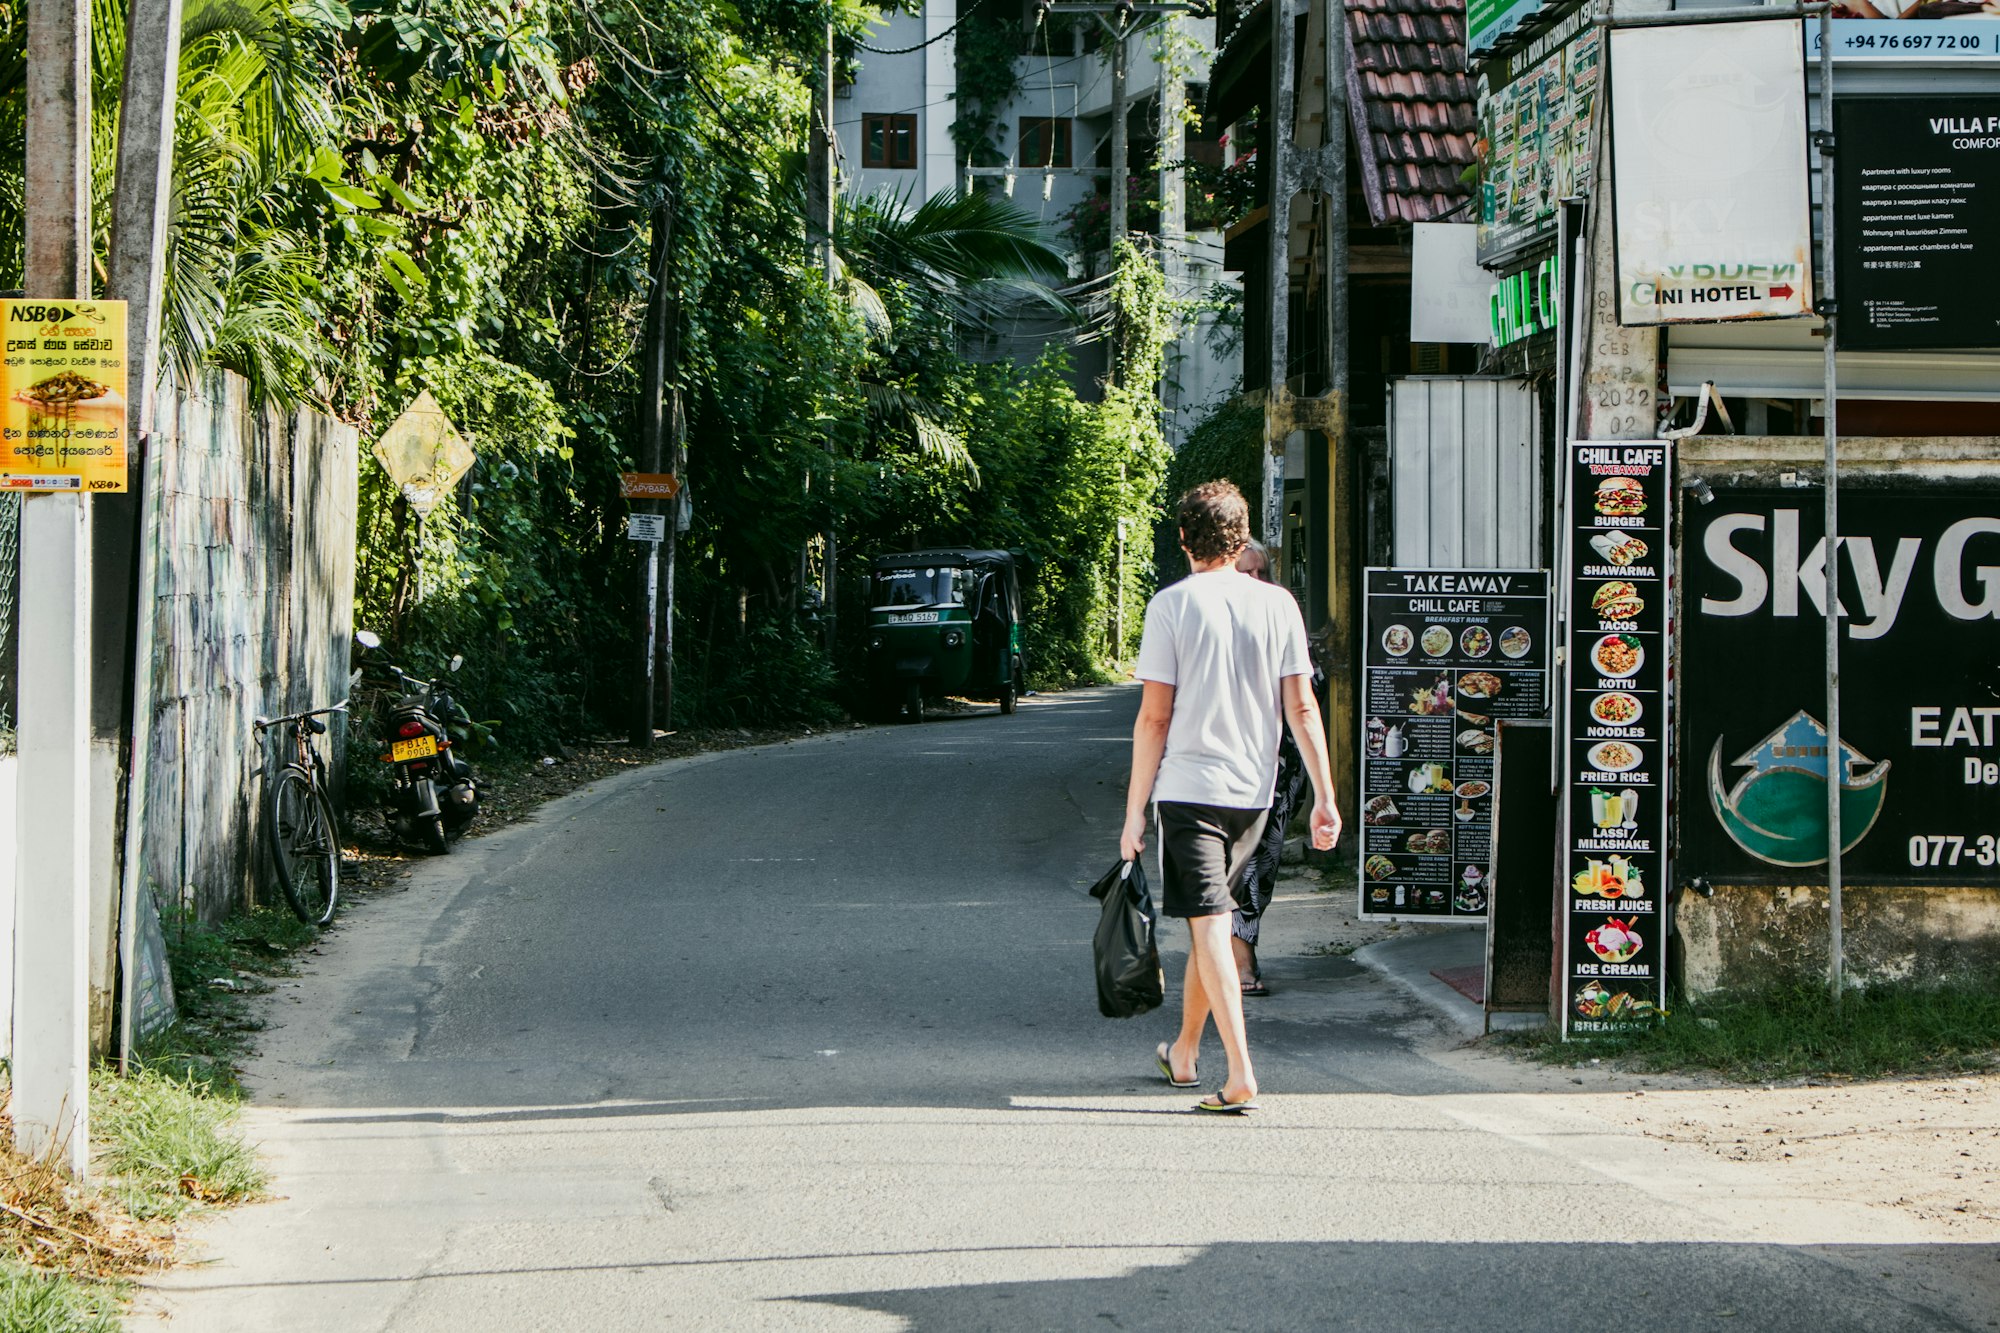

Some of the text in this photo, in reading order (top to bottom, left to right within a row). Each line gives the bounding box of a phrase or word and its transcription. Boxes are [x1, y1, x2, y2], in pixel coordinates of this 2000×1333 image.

[1845, 35, 1980, 48] +94 76 697 72 00
[1528, 36, 1543, 65] MOON
[1929, 117, 2000, 134] VILLA F
[1691, 286, 1761, 303] HOTEL
[10, 306, 46, 322] NSB
[1490, 270, 1538, 348] CHILL
[1599, 388, 1649, 407] 2022
[1578, 448, 1663, 466] CHILL CAFE
[1589, 465, 1652, 476] TAKEAWAY
[89, 481, 107, 489] NSB
[626, 484, 672, 496] CAPYBARA
[1594, 516, 1645, 527] BURGER
[1583, 566, 1656, 577] SHAWARMA
[1701, 508, 1922, 640] Sky
[1403, 575, 1511, 593] TAKEAWAY
[1409, 599, 1445, 612] CHILL
[1448, 600, 1480, 612] CAFE
[1599, 621, 1638, 631] TACOS
[1598, 679, 1636, 689] KOTTU
[1587, 726, 1645, 738] NOODLES
[1912, 707, 2000, 746] EAT
[1580, 771, 1649, 783] FRIED RICE
[1964, 757, 2000, 785] De
[1593, 828, 1628, 838] LASSI
[1578, 839, 1650, 850] MILKSHAKE
[1909, 834, 2000, 867] 077-3
[1575, 899, 1653, 911] FRESH JUICE
[1576, 963, 1649, 975] ICE CREAM
[1574, 1021, 1650, 1032] BREAKFAS
